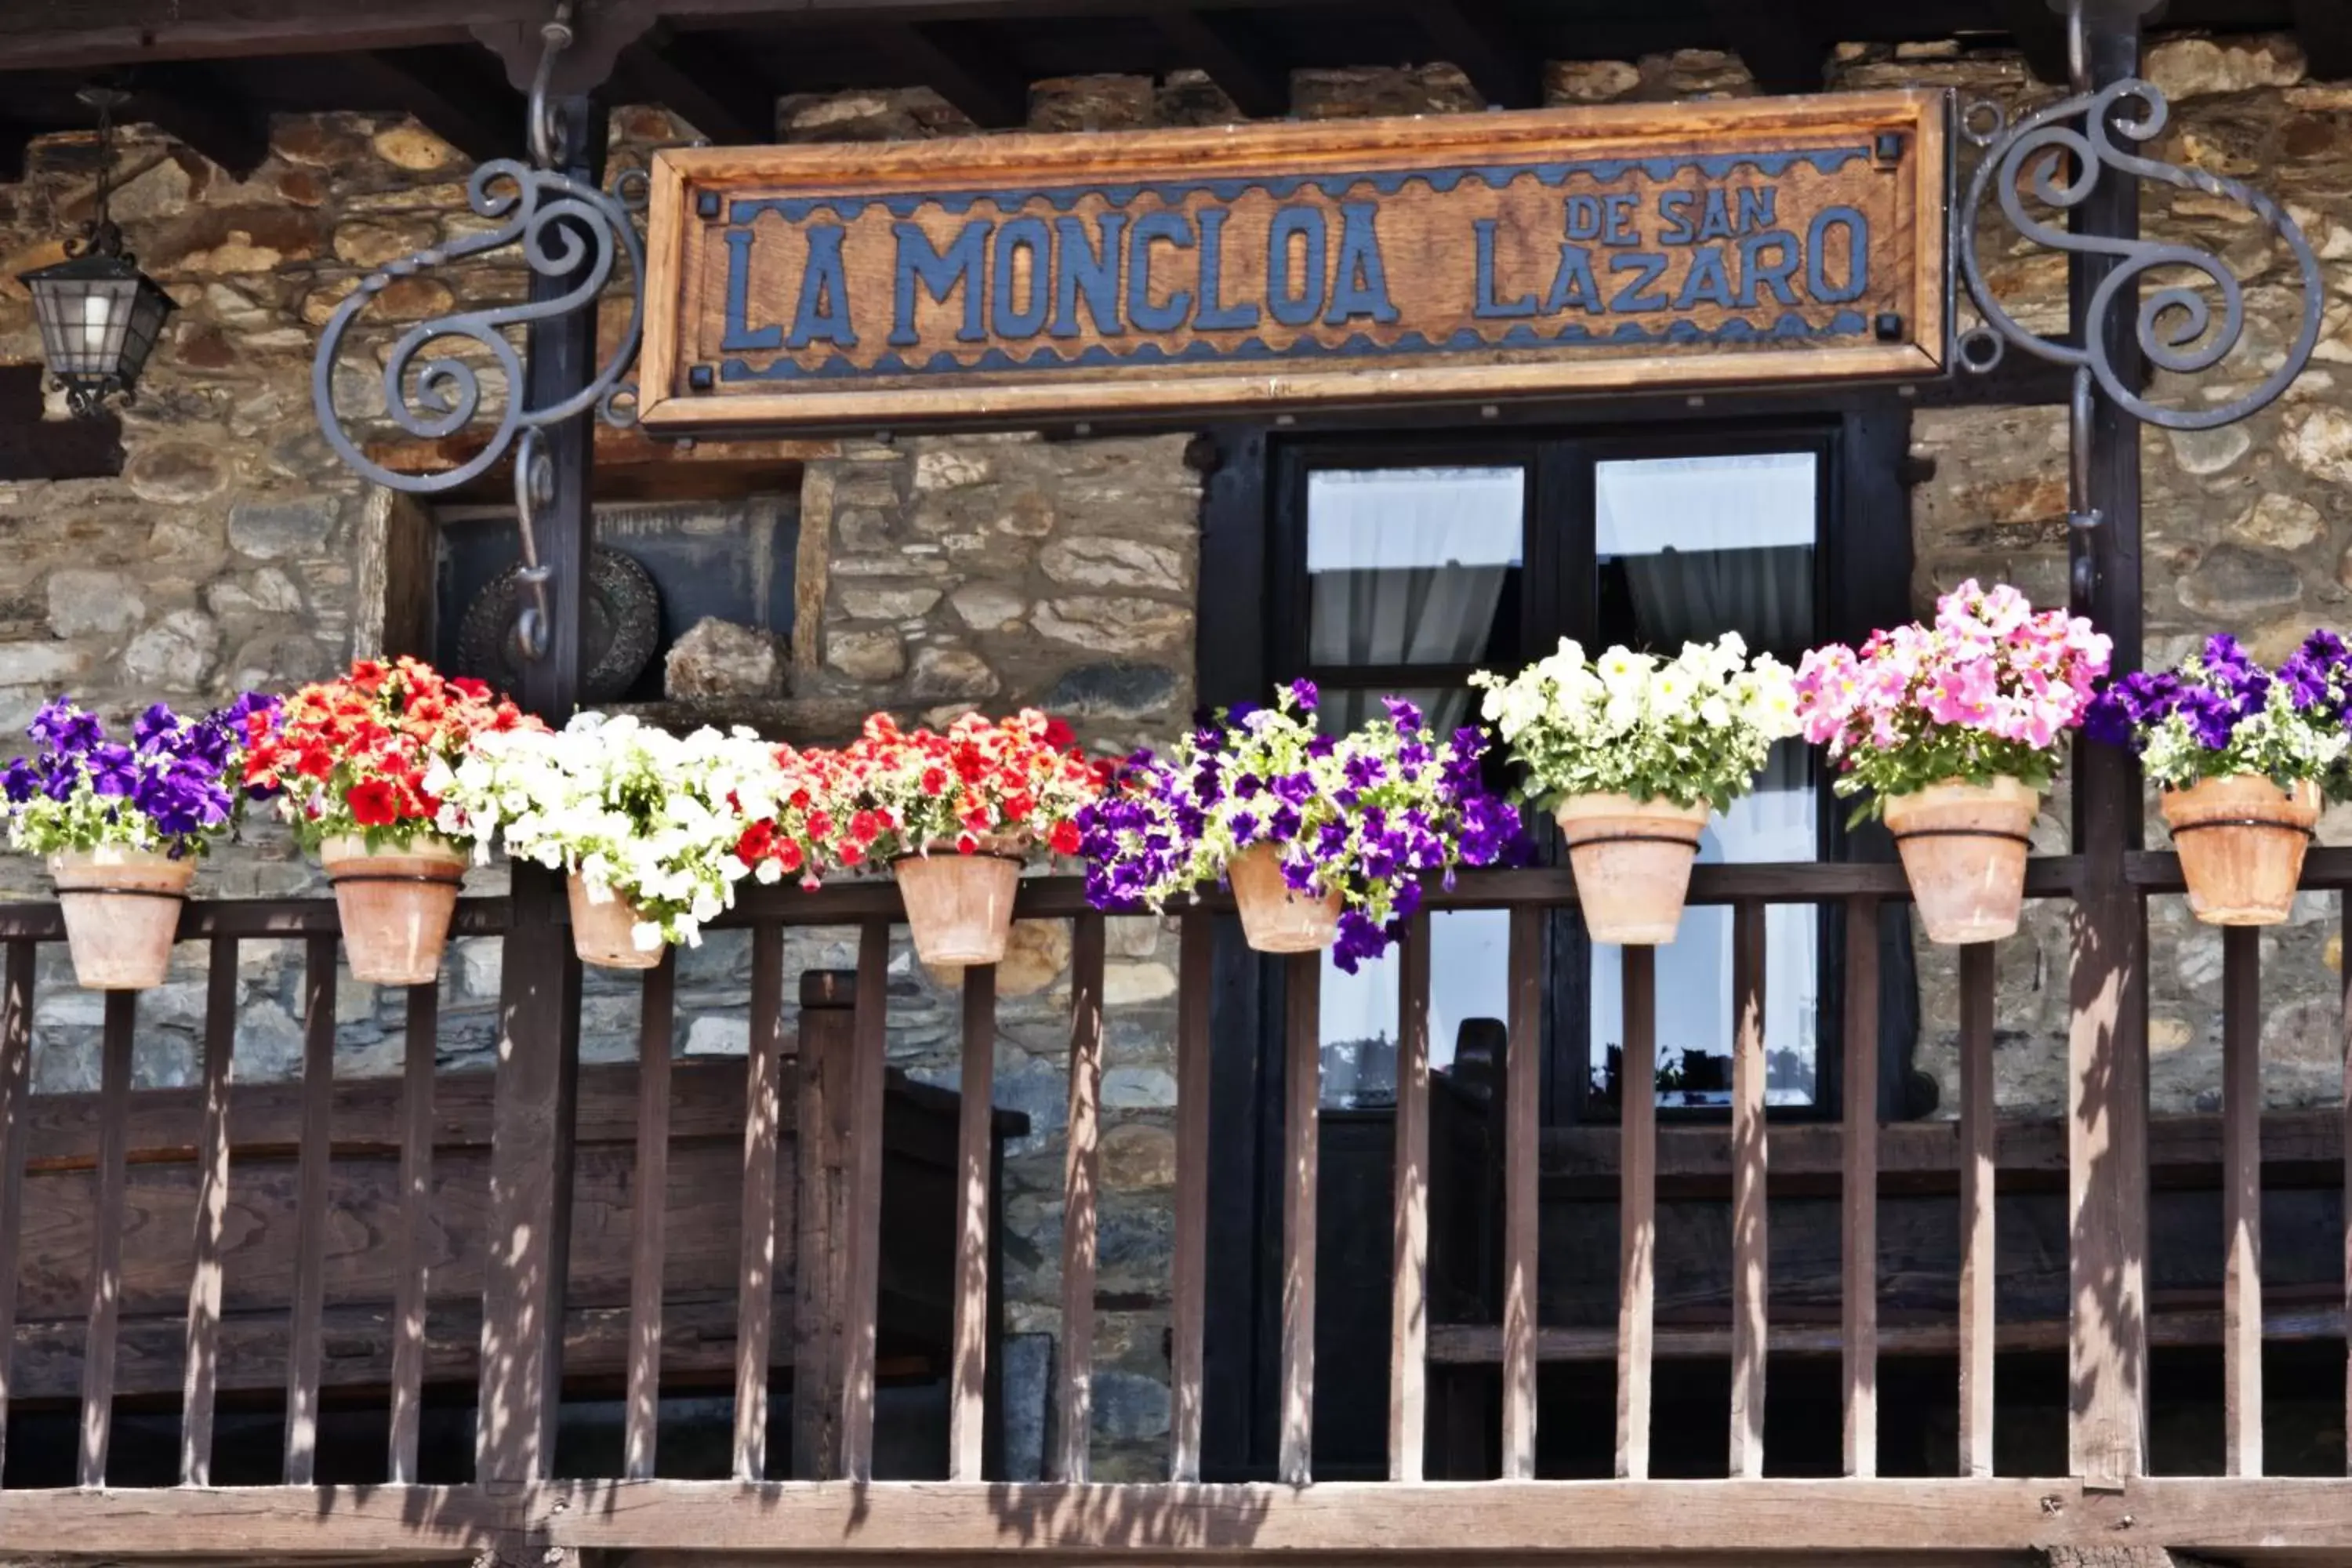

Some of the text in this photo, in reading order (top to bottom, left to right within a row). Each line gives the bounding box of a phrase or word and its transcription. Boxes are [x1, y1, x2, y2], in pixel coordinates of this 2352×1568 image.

[1473, 206, 1869, 318] LAZARO
[1566, 187, 1777, 245] DE SAN
[721, 203, 1399, 350] LA MONCLOA
